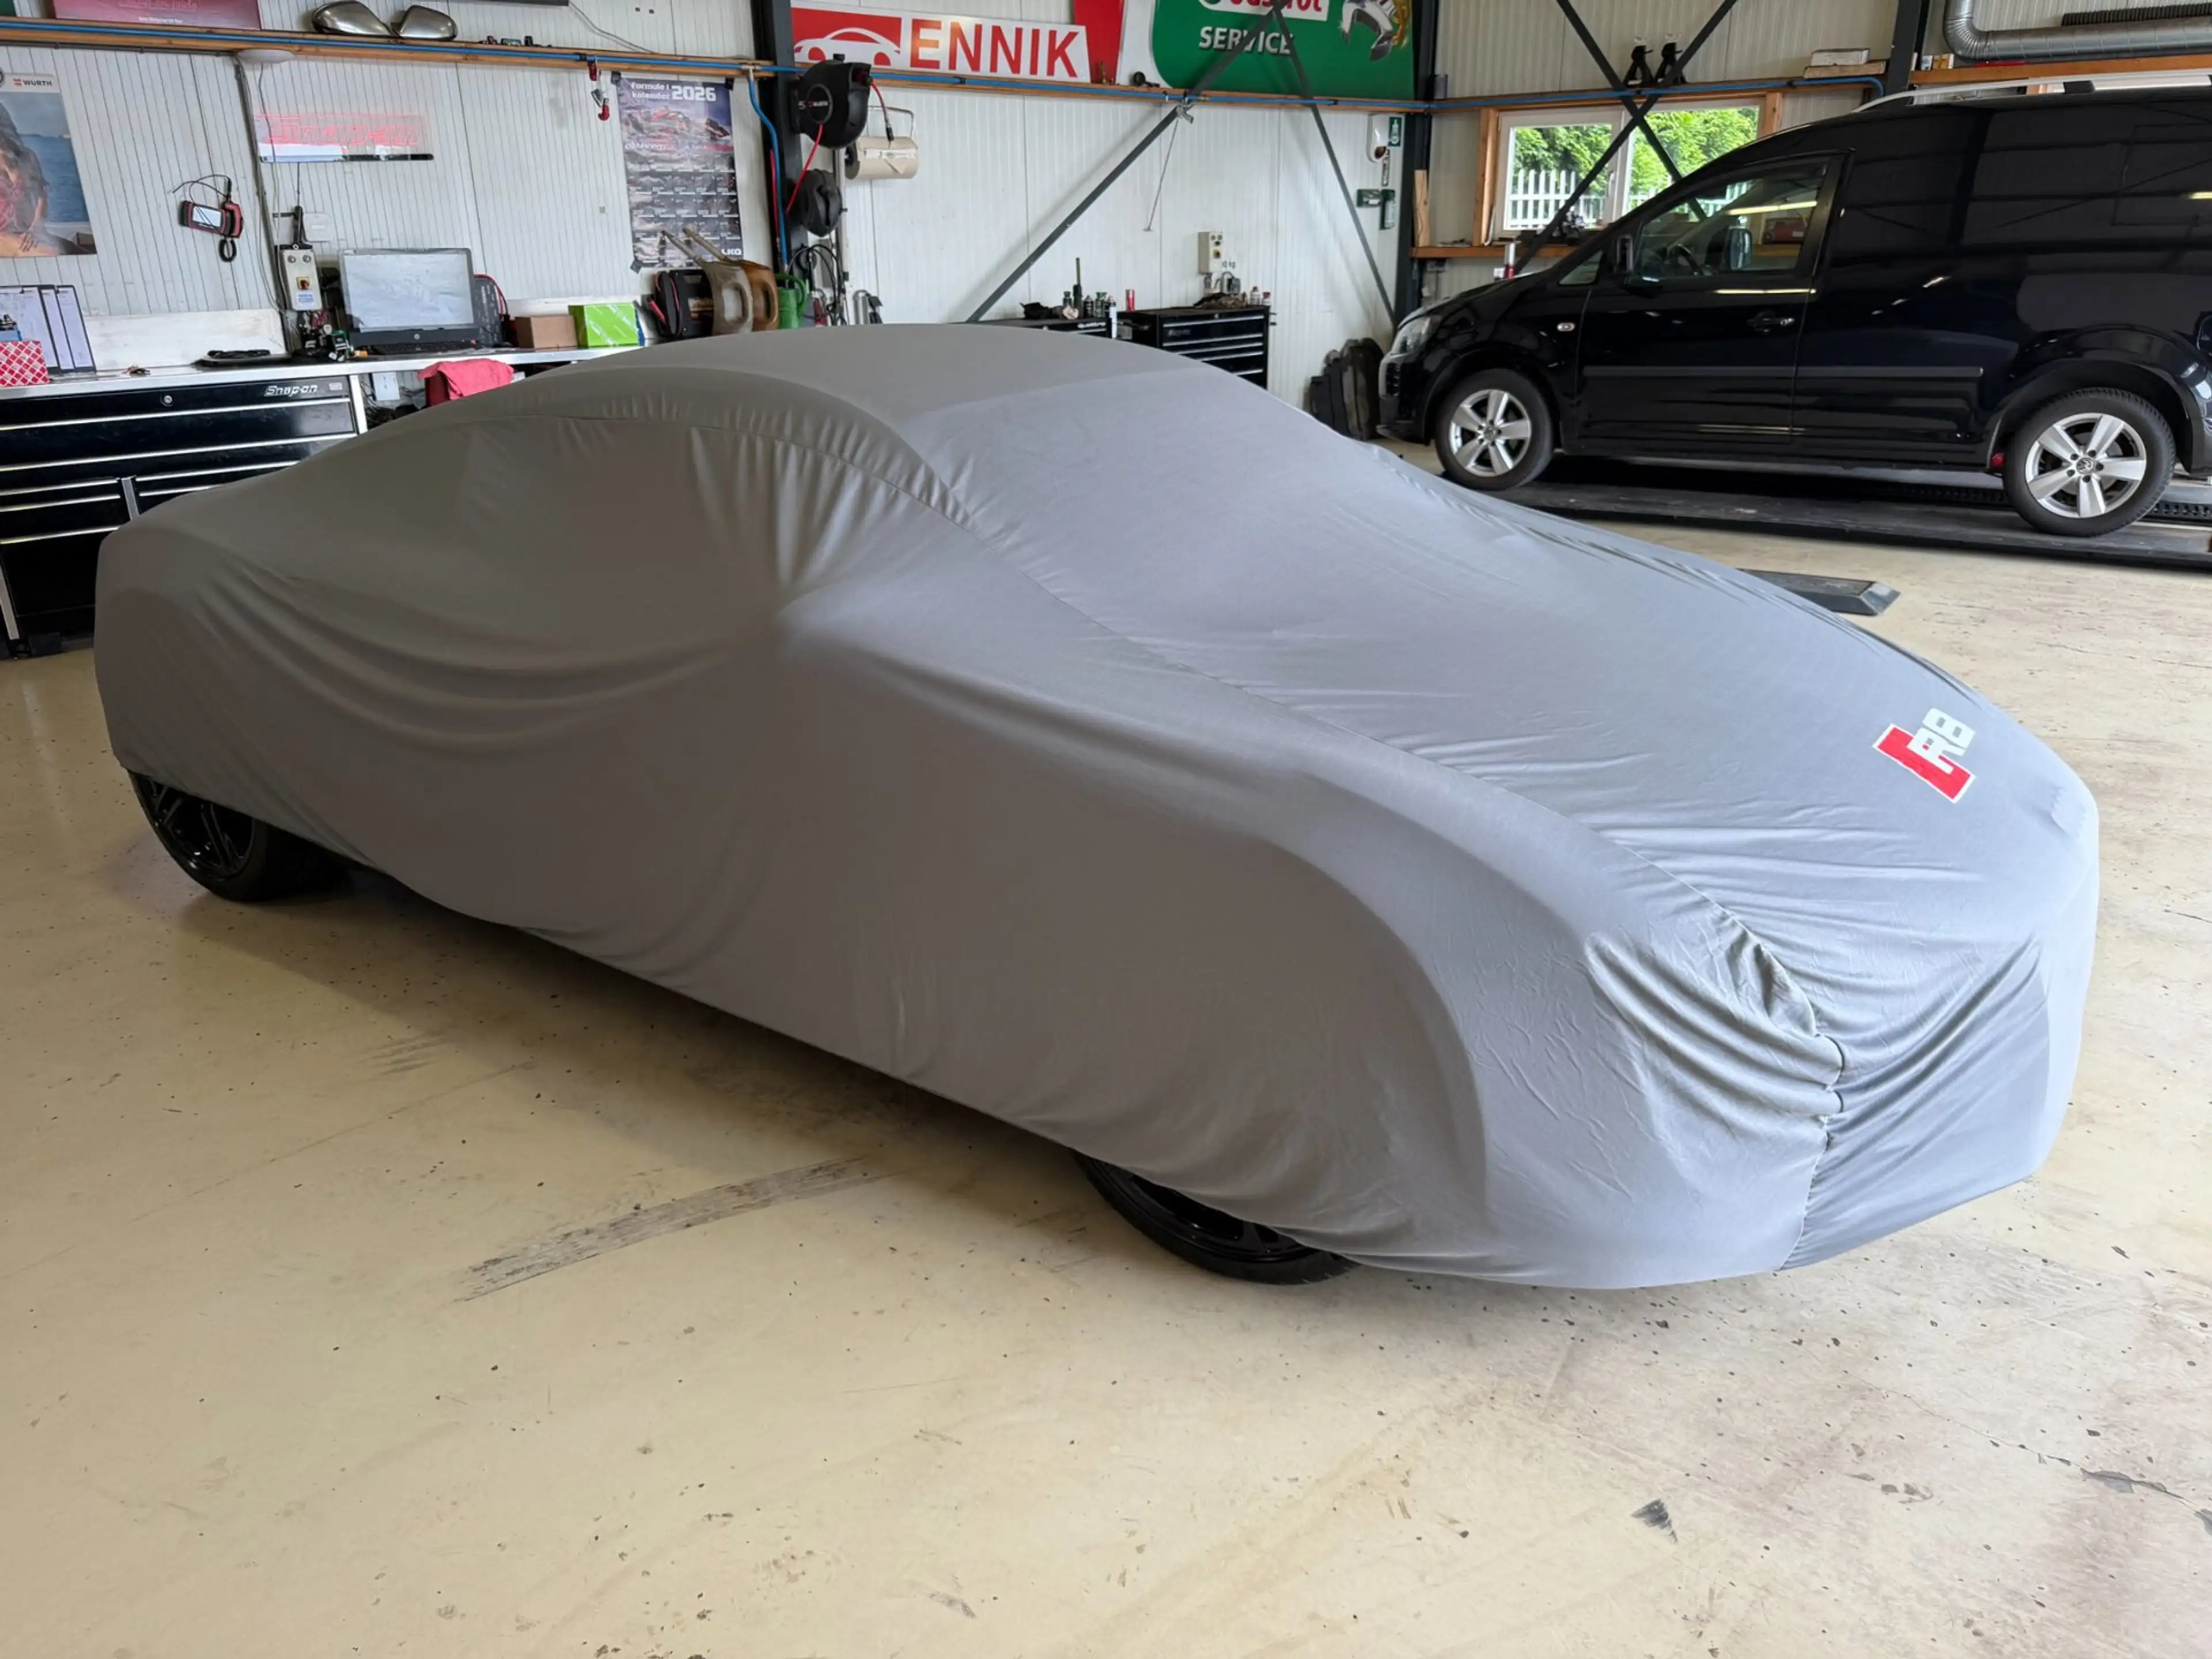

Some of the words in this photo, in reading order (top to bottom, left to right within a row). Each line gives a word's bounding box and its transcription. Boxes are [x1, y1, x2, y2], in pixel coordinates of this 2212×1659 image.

[910, 18, 1079, 78] ENNIK
[671, 86, 717, 102] 2026
[264, 384, 318, 397] Snap-on
